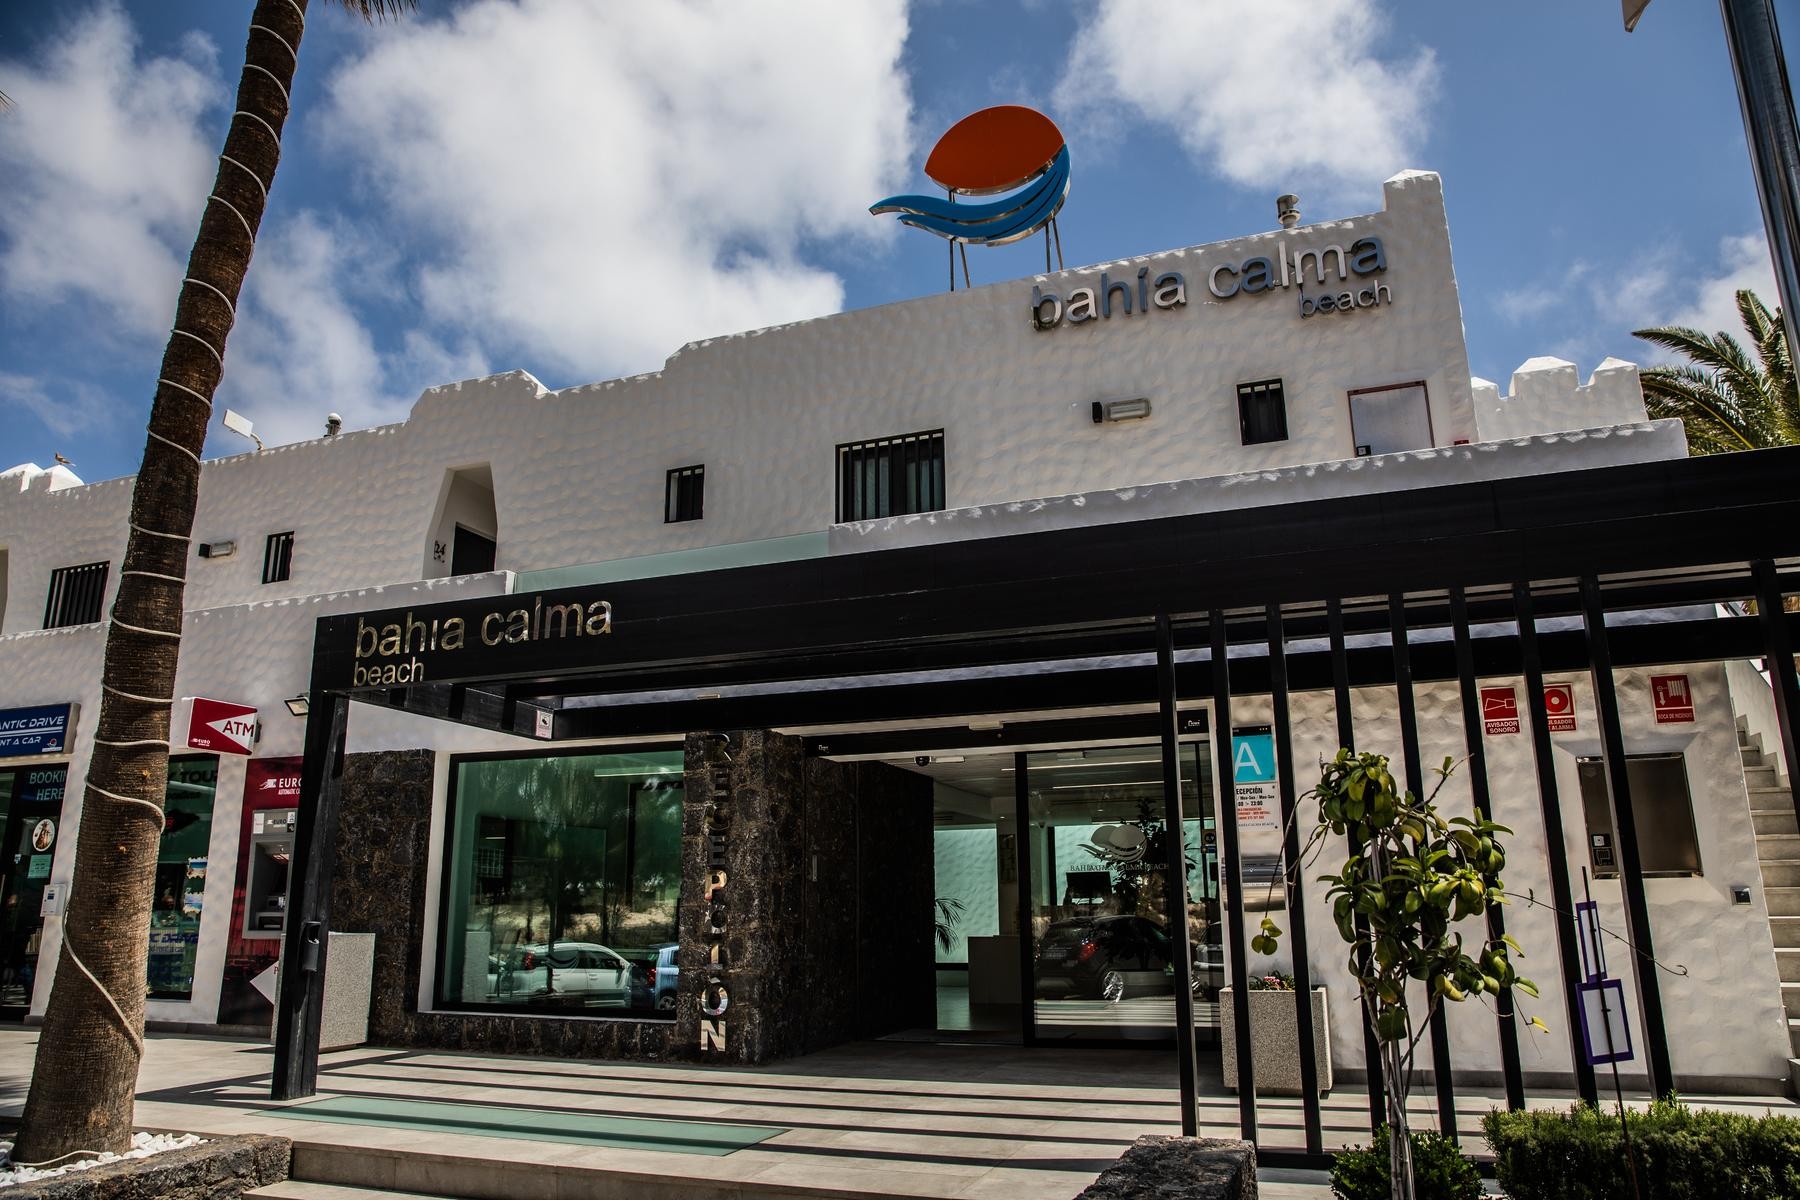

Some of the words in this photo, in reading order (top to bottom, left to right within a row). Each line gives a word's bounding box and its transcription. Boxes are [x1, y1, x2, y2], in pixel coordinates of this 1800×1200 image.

[1032, 267, 1187, 331] bahía
[1208, 235, 1387, 299] calma
[1300, 280, 1392, 319] beach
[481, 596, 613, 647] calma
[353, 656, 425, 687] beach
[29, 715, 65, 728] DRIVE
[222, 720, 255, 738] ATM
[1486, 721, 1519, 729] AVISADOR
[1489, 726, 1517, 734] SONORO
[22, 736, 42, 745] CAR
[1234, 741, 1262, 777] A
[36, 787, 64, 800] HERE
[1236, 786, 1263, 796] ECEPCIÓN
